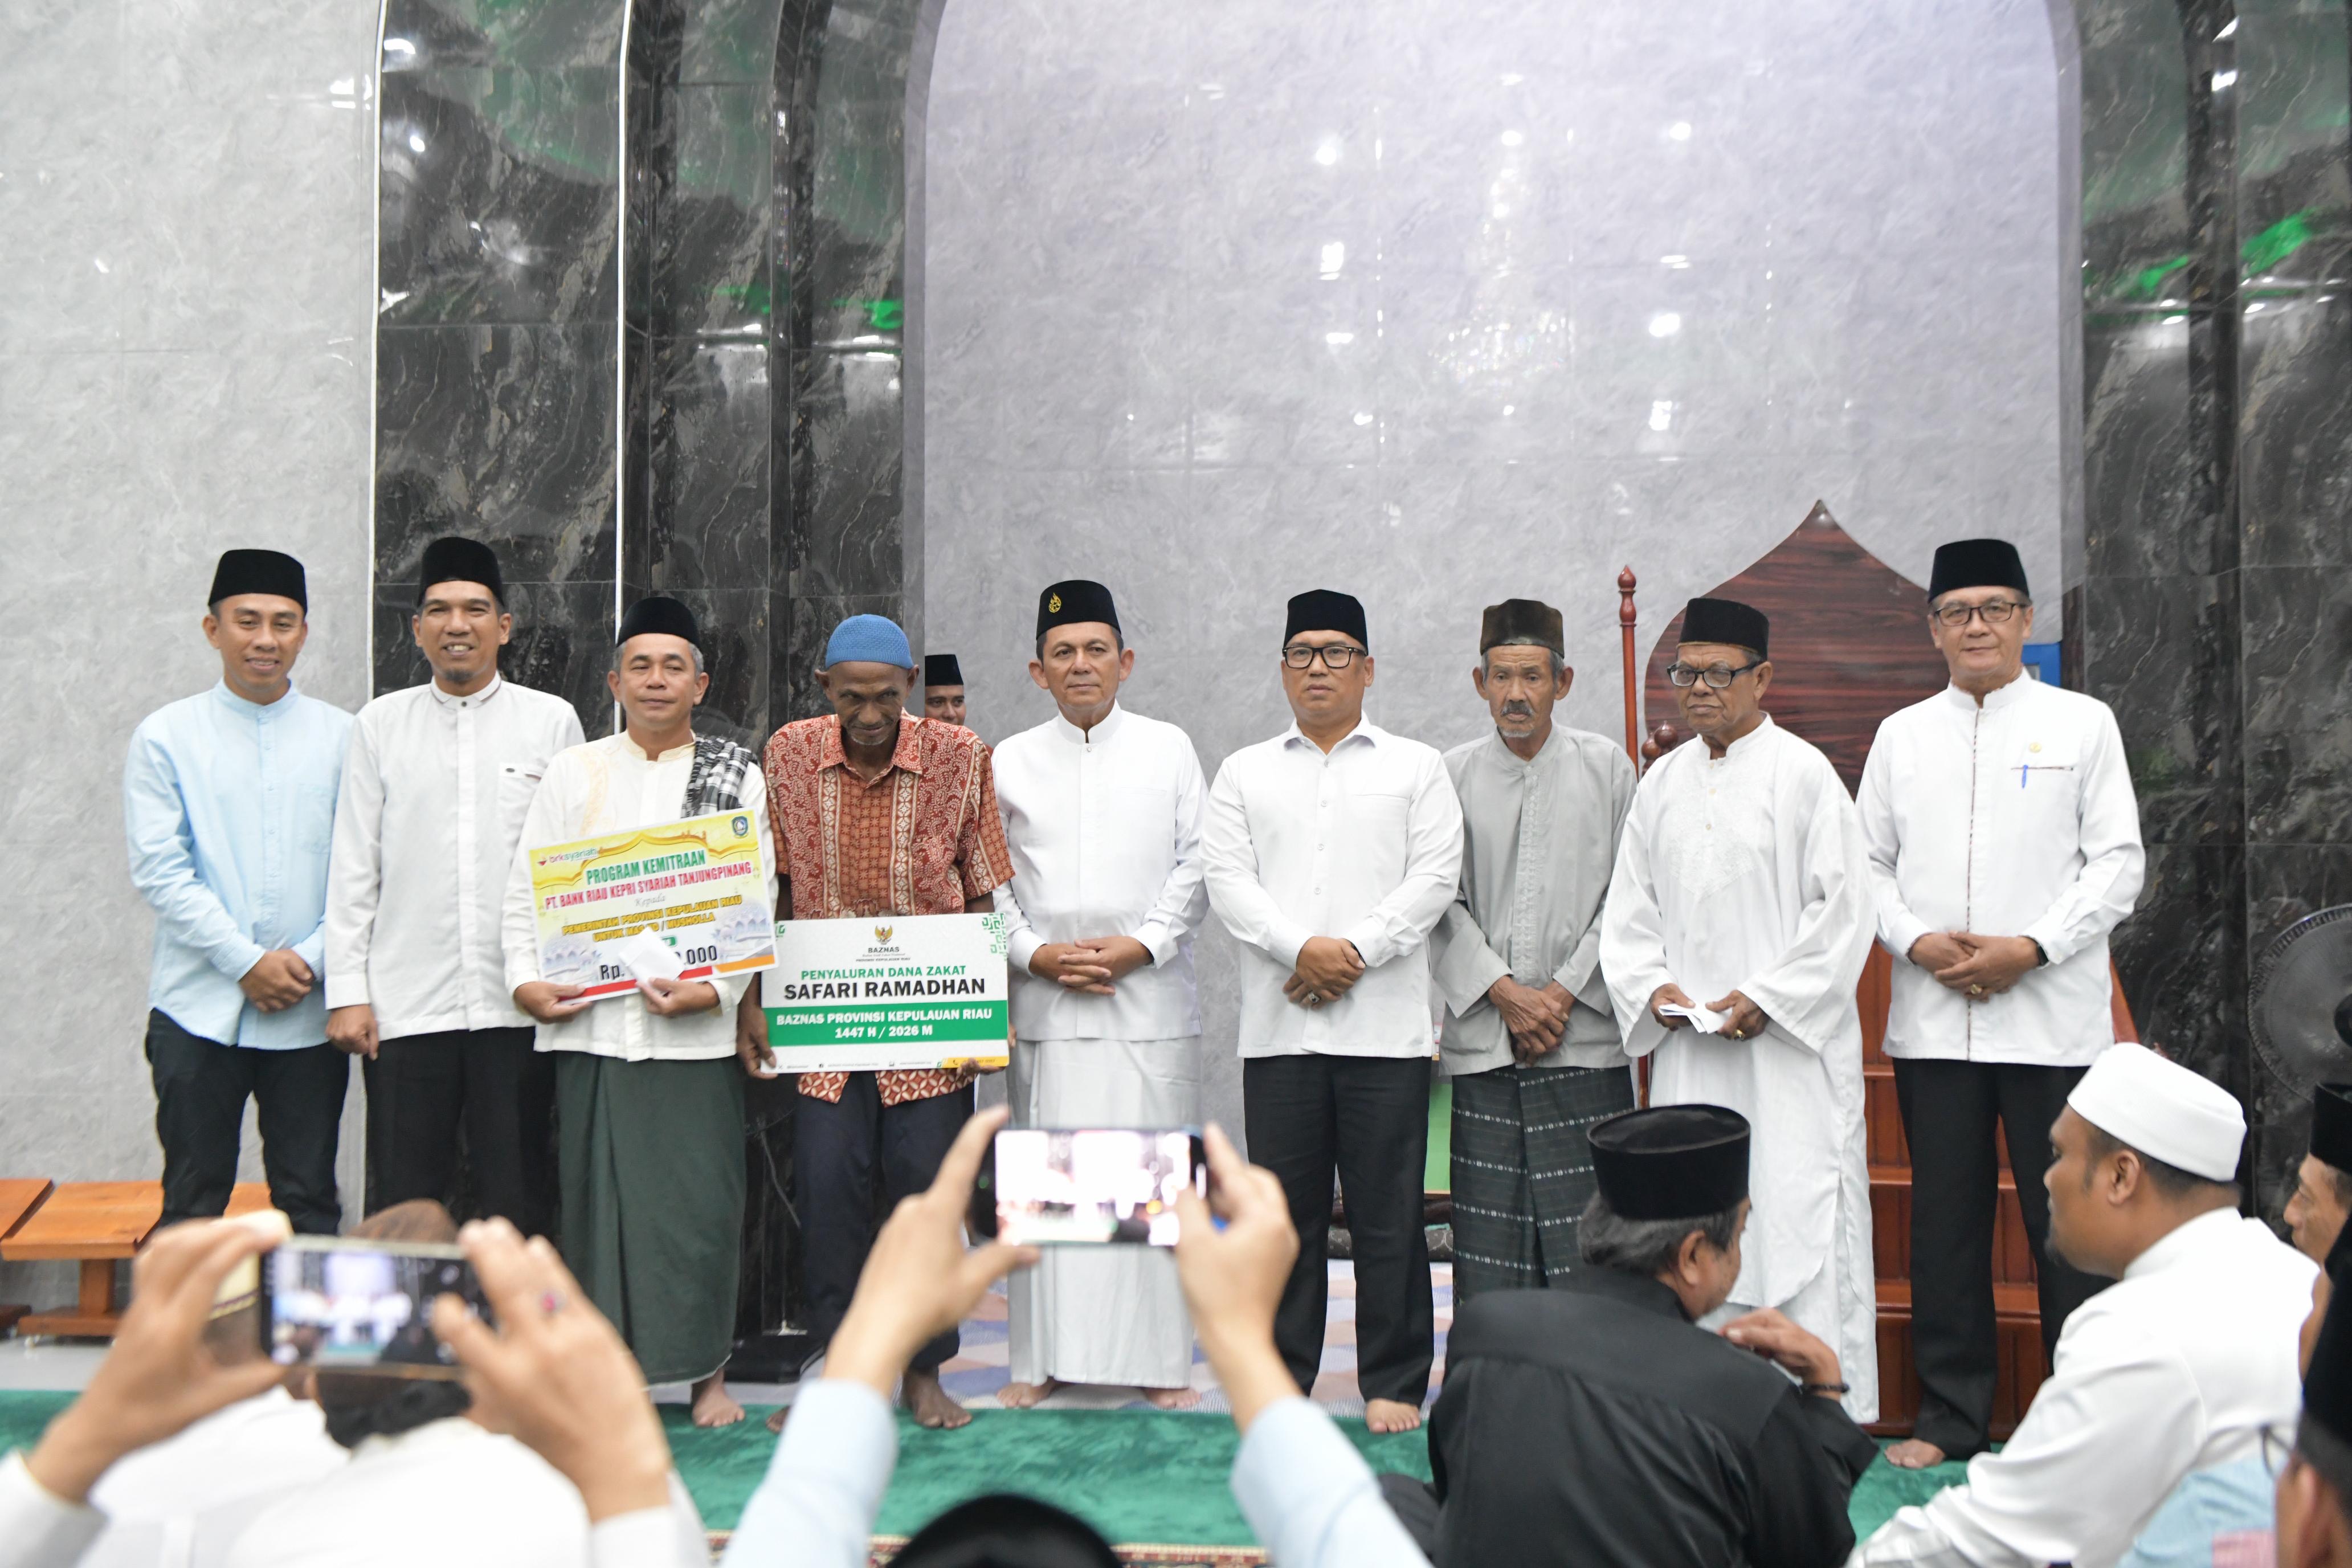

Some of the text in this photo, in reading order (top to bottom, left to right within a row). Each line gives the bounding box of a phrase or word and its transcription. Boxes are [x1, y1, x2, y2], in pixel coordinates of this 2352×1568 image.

[586, 850, 706, 885] PROGRAM KEMITRAAN
[546, 861, 752, 909] PT. BANK RIAU KEPRI SYARIAH TANJUNGPINANG
[635, 893, 666, 907] Kepada
[562, 895, 742, 936] PEMERINTAH PROVINSI KEPULAUAN RIAU
[593, 912, 716, 942] UNTUK MASD / MUSHOLLA
[600, 965, 625, 981] Rp.
[801, 965, 966, 980] PENYALURAN DANA ZAKAT
[784, 978, 985, 1000] SAFARI RAMADHAN
[777, 1008, 992, 1026] BAZNAS PROVINSI KEPULAUAN RIAU
[835, 1024, 933, 1039] 1447 H / 2026 M
